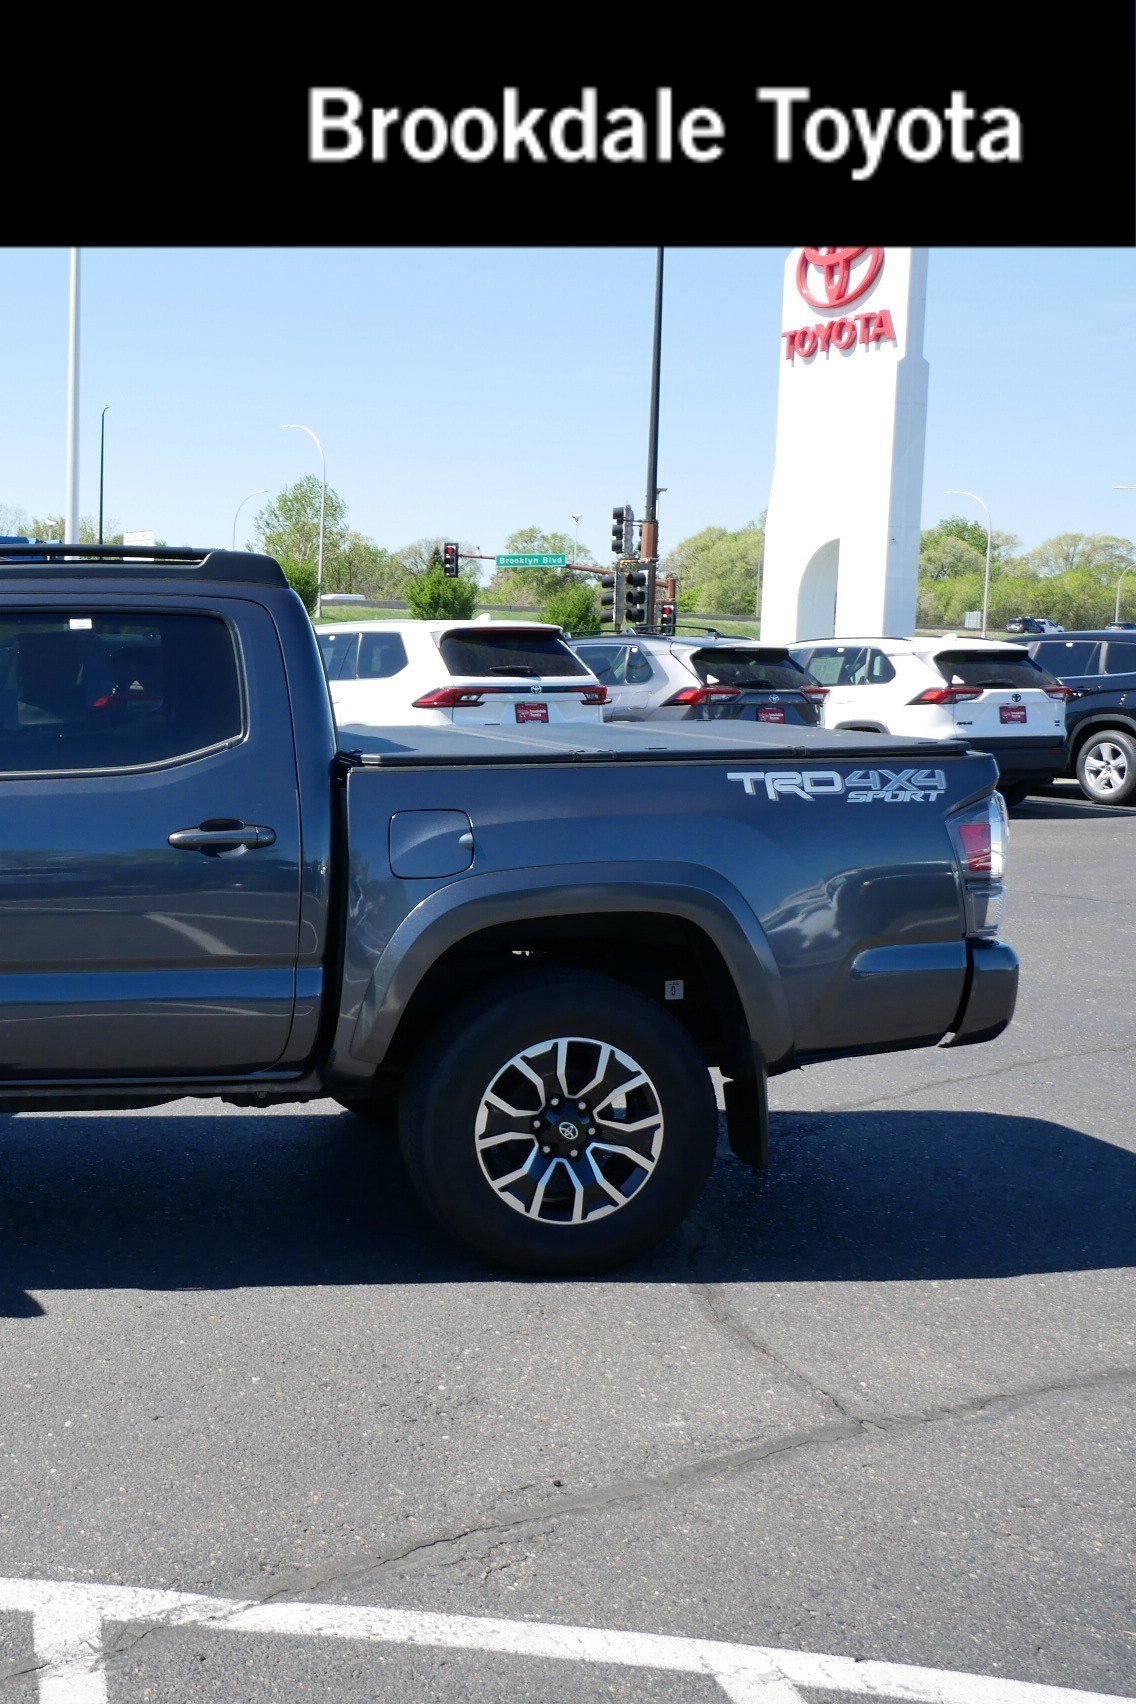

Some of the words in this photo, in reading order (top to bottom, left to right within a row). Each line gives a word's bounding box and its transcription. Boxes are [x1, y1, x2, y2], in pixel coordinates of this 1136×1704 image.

[781, 309, 897, 361] TOYOTA
[499, 556, 539, 566] Brooklyn
[542, 556, 563, 565] Blvd
[726, 771, 846, 802] TRD
[845, 789, 946, 803] SPORT
